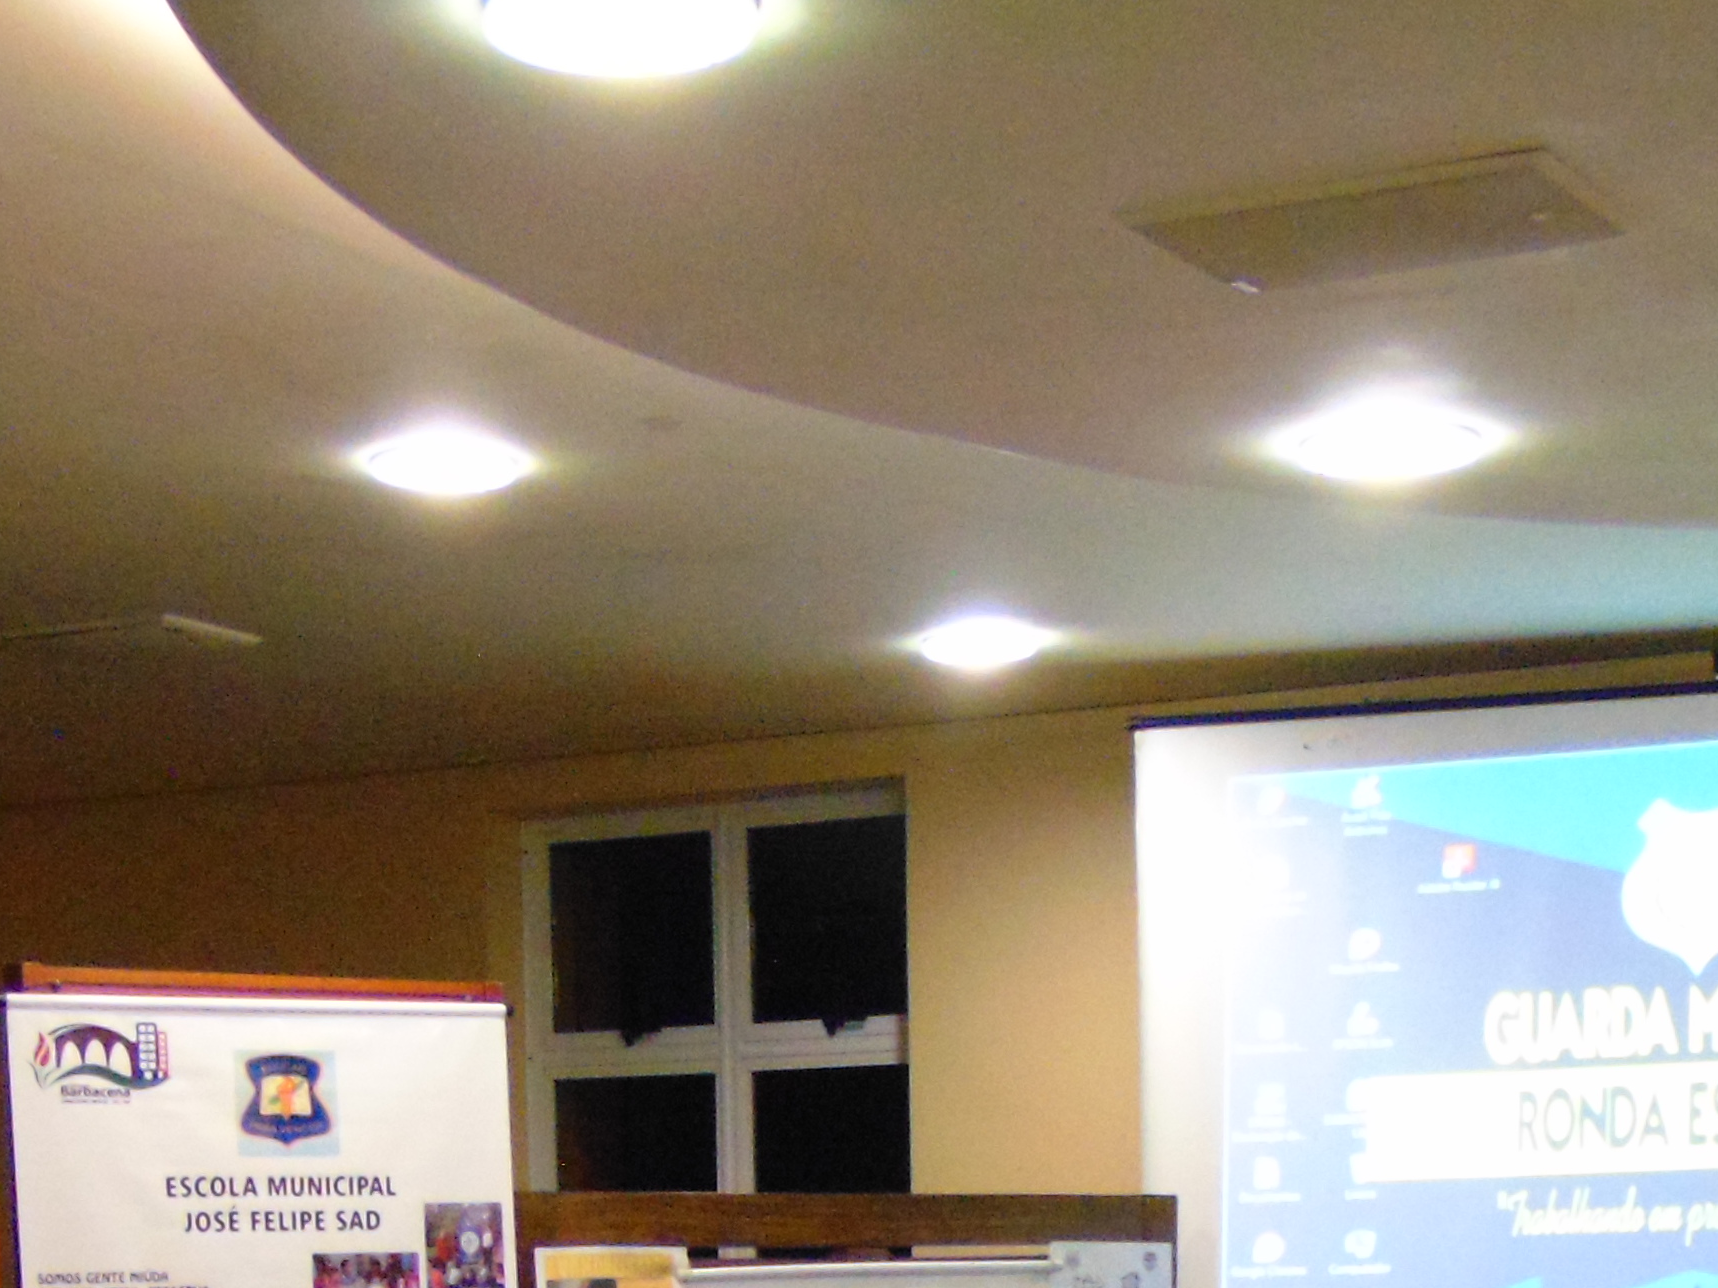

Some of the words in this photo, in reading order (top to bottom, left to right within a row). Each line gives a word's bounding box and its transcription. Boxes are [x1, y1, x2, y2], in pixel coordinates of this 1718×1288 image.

[1482, 984, 1680, 1066] GUARDA
[60, 1084, 131, 1098] Barbacena
[1517, 1085, 1669, 1152] RONDA
[165, 1175, 259, 1198] ESCOLA
[267, 1175, 397, 1198] MUNICIPAL
[184, 1204, 240, 1233] JOSÉ
[251, 1210, 326, 1232] FELIPE
[335, 1209, 381, 1232] SAD
[38, 1271, 82, 1284] SOMOS
[86, 1271, 125, 1284] GENTE
